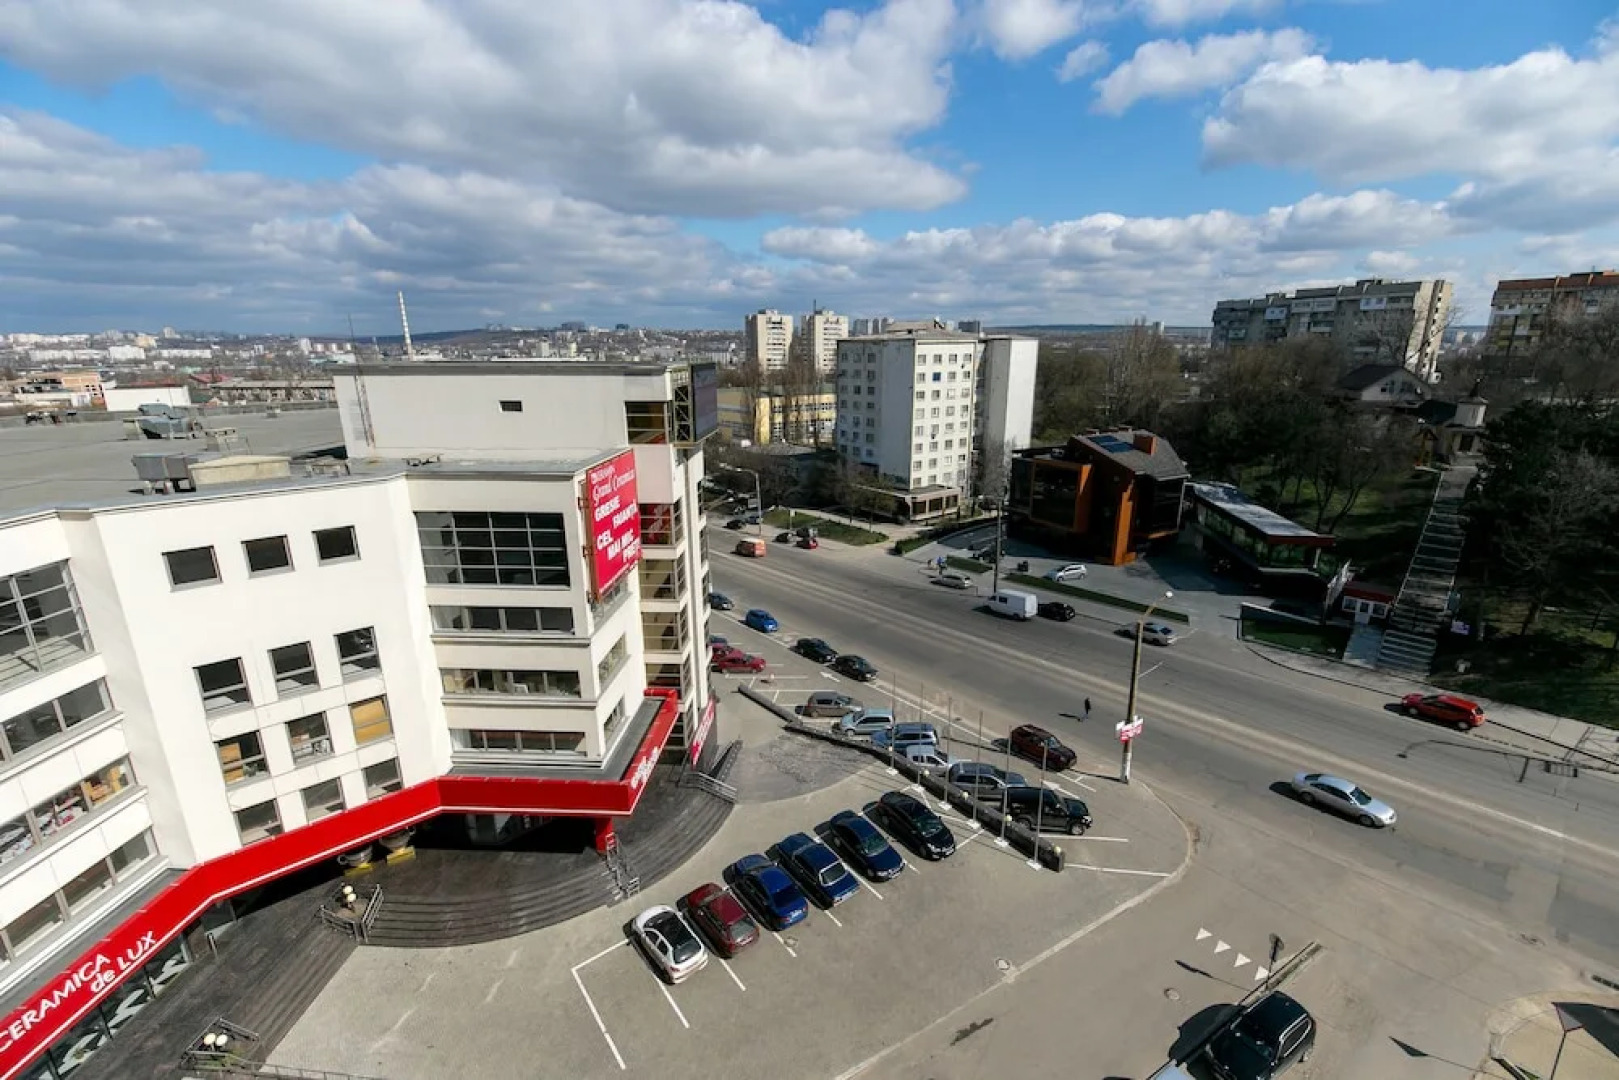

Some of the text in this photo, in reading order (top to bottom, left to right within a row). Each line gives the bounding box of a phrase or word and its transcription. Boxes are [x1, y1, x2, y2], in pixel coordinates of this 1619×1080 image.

[597, 529, 613, 550] CEL
[607, 528, 634, 561] MAI MIC
[90, 931, 157, 993] de LUX
